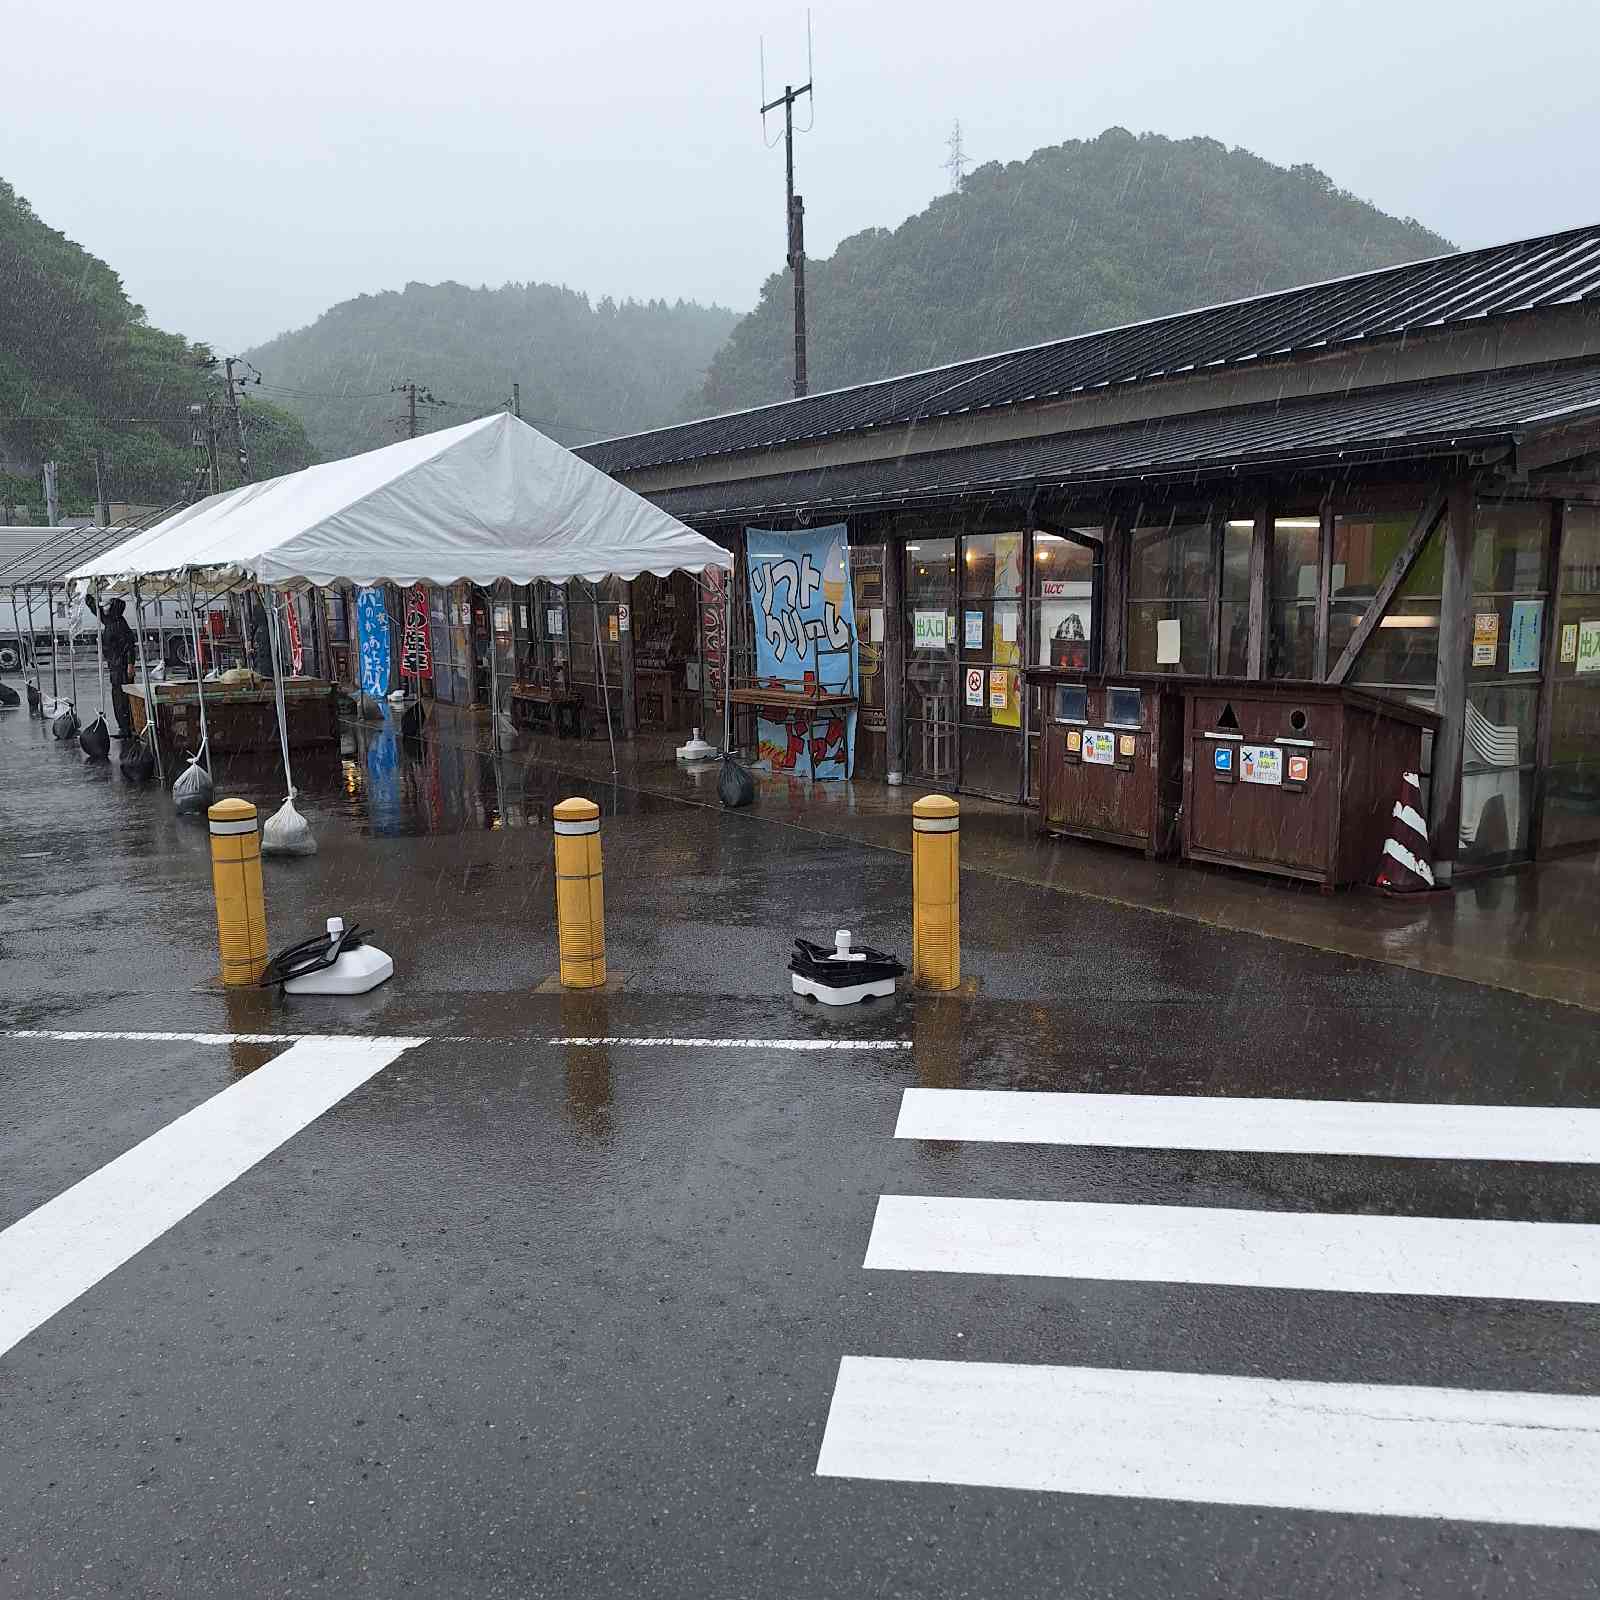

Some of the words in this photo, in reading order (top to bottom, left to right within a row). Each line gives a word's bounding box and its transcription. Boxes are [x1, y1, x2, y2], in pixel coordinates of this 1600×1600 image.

[751, 554, 821, 615] ソフト
[1044, 583, 1065, 595] UCC
[765, 601, 848, 662] クリーム
[916, 617, 944, 638] 出入口
